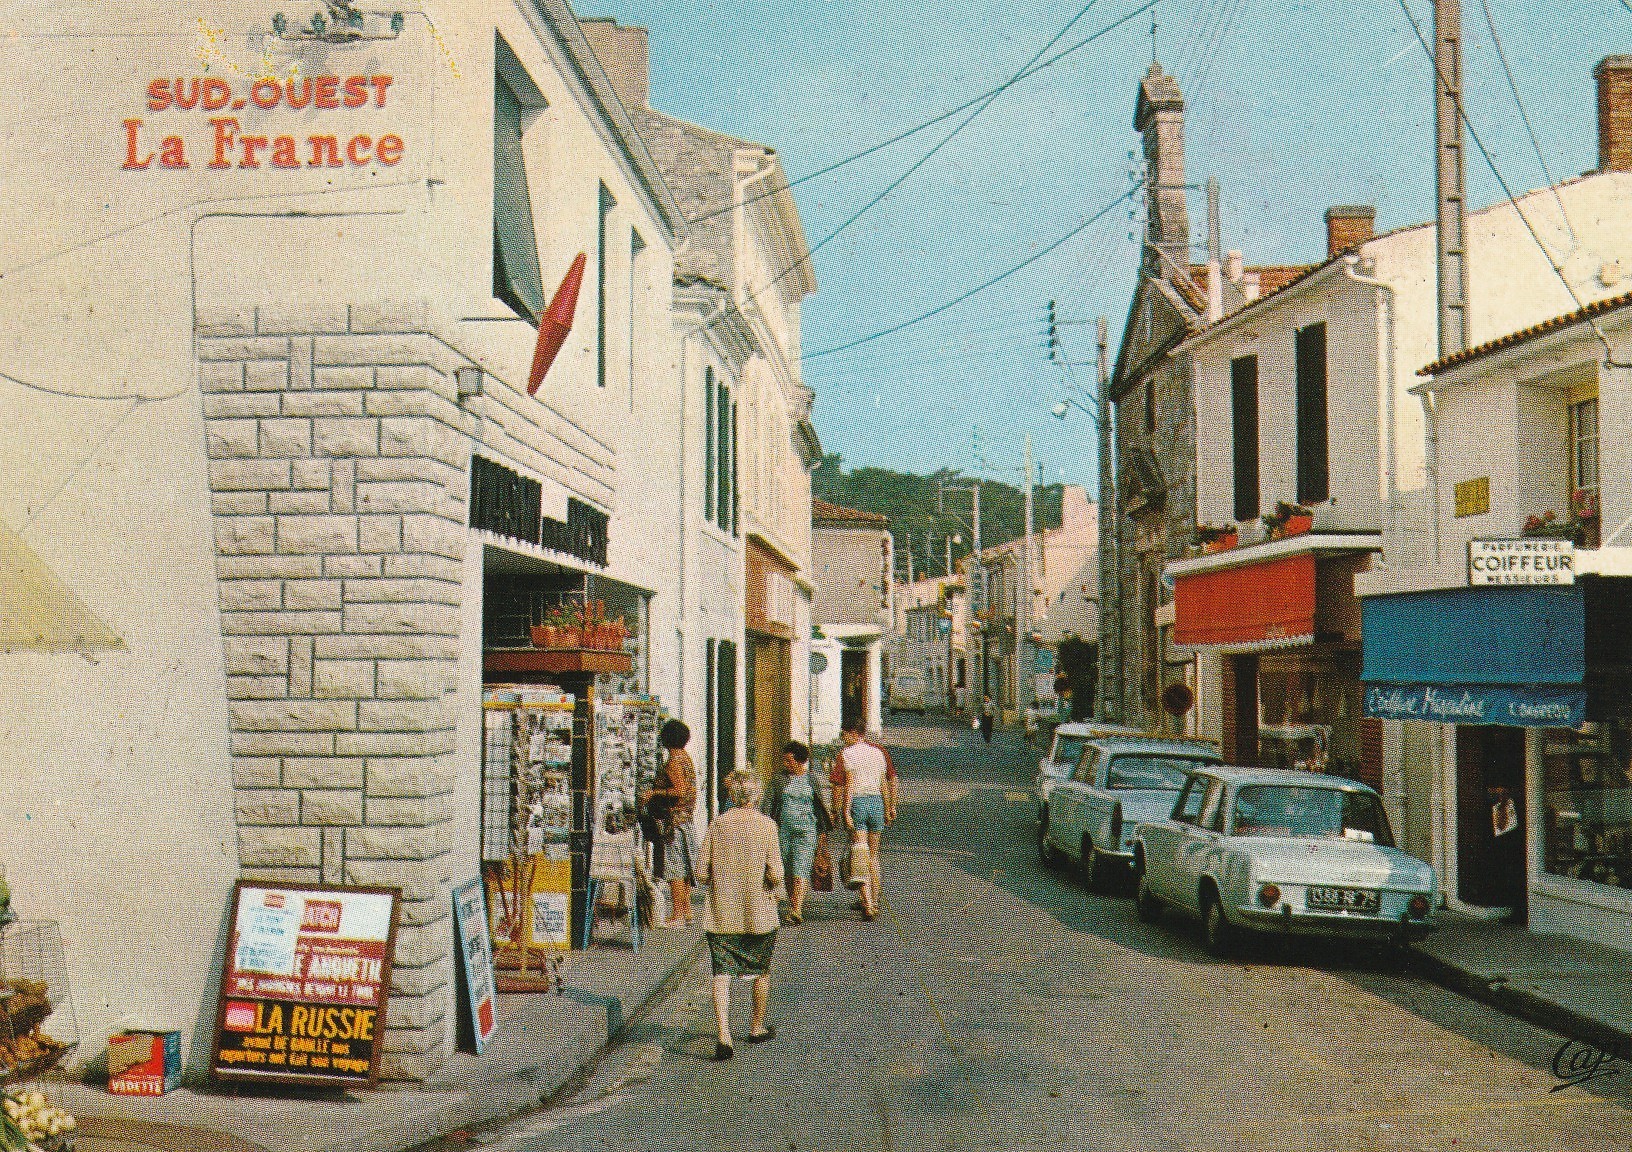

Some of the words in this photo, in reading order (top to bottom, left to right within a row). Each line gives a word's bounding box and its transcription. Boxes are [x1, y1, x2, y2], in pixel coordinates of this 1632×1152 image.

[121, 117, 189, 169] La
[208, 117, 405, 169] France
[1481, 541, 1560, 552] PARFUMERIE
[1472, 554, 1573, 572] COIFFEUR
[1486, 574, 1559, 584] MESSIEURS
[305, 905, 340, 927] ATCH
[256, 1003, 283, 1034] LA
[291, 1005, 376, 1041] RUSSIE
[274, 1035, 288, 1050] DE
